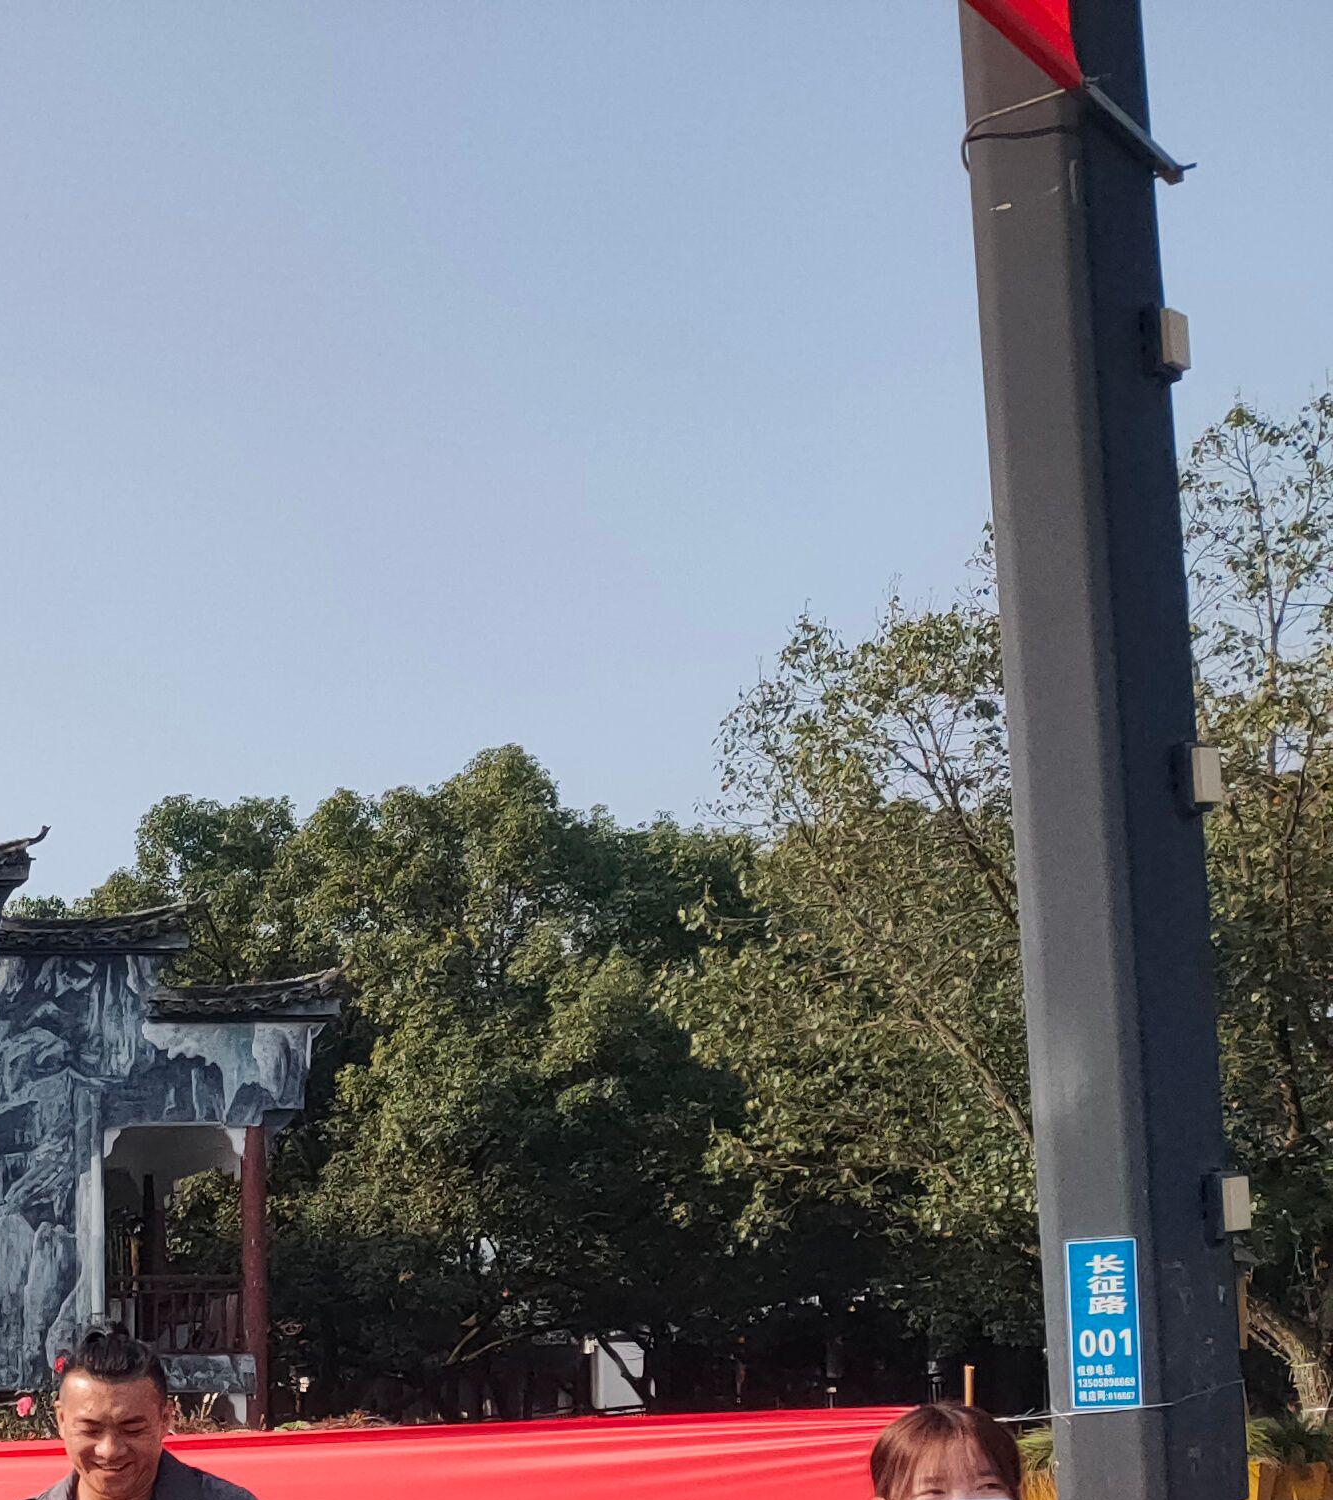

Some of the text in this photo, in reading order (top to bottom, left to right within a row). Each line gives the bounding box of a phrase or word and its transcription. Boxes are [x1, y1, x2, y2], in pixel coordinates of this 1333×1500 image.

[1086, 1254, 1127, 1315] 长征路
[1079, 1328, 1132, 1357] 001
